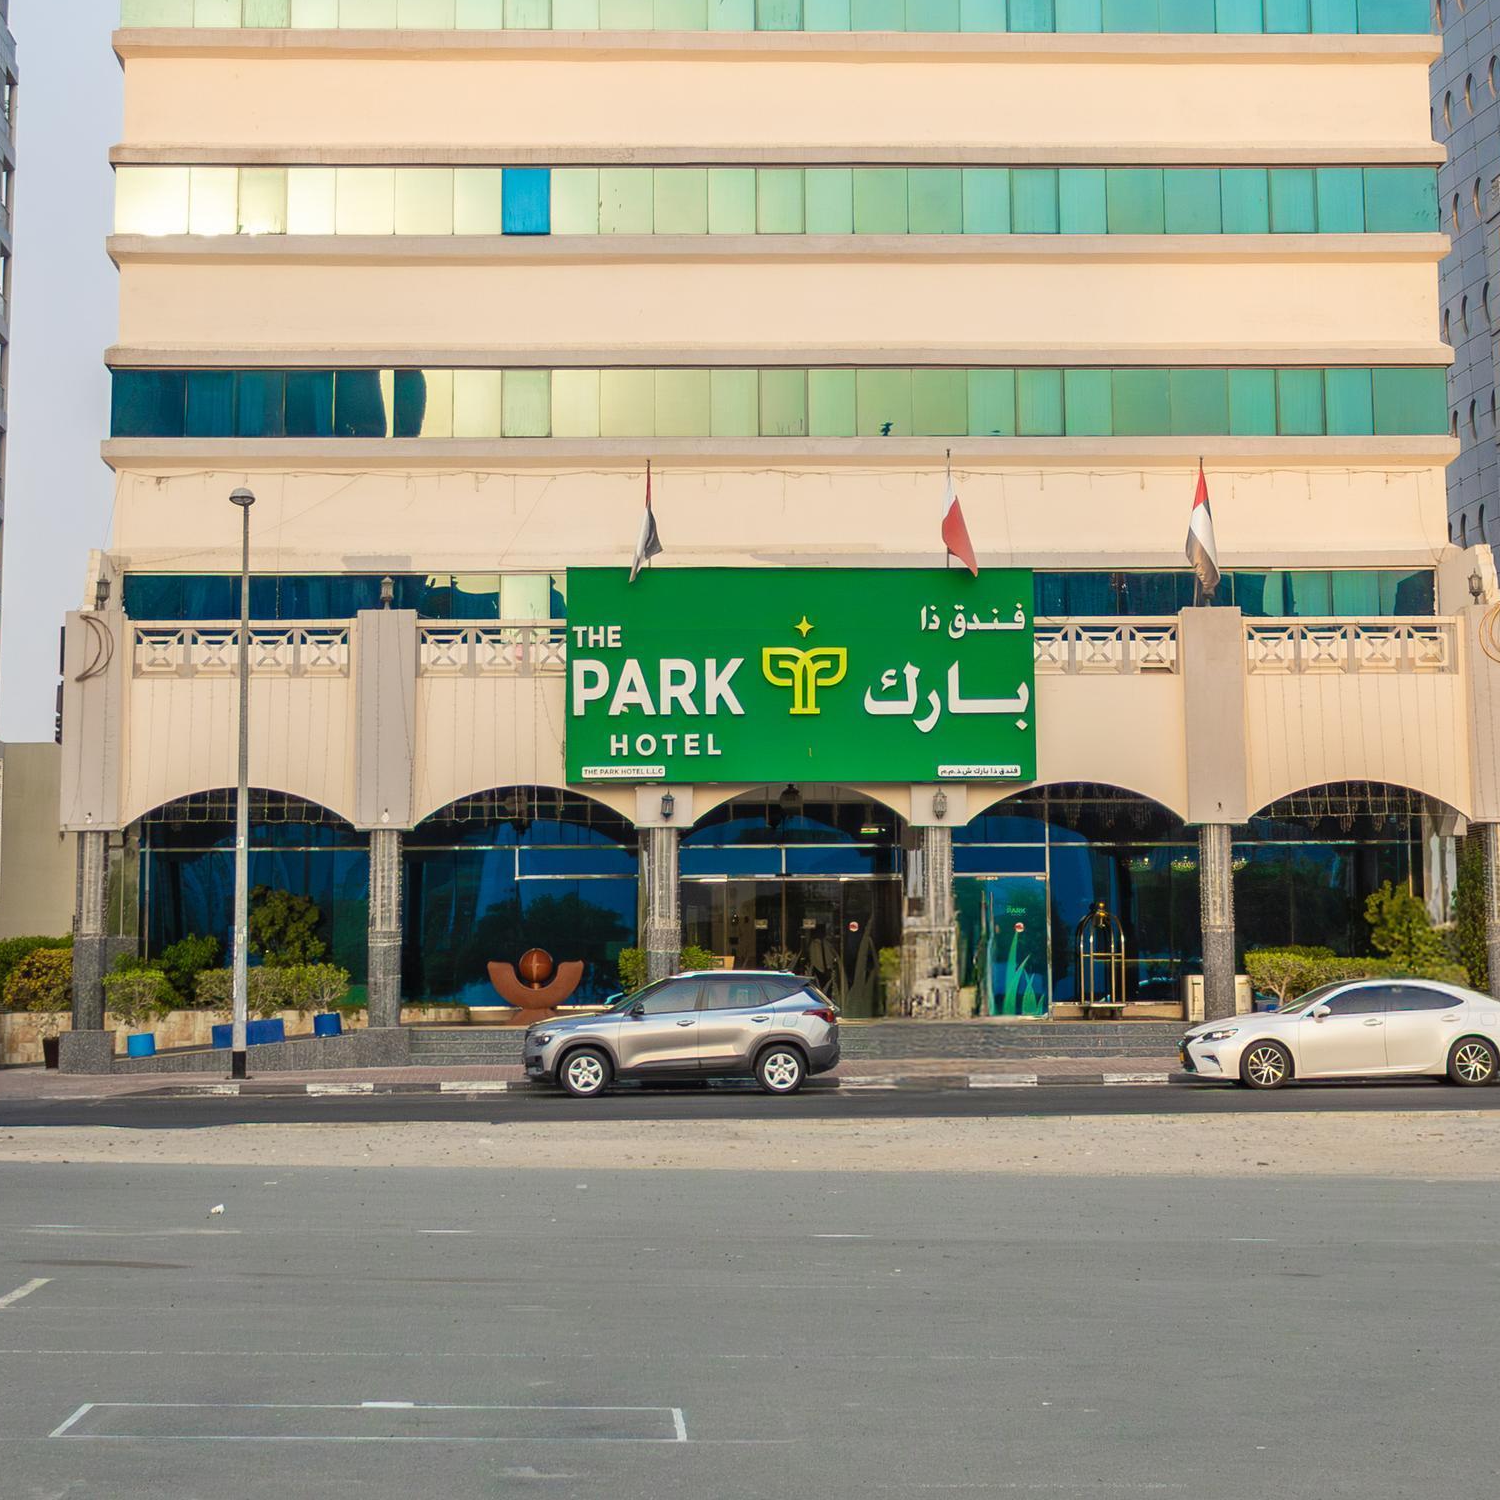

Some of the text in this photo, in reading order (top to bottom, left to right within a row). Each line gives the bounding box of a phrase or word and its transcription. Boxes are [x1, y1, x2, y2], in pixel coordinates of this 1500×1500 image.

[919, 603, 1027, 639] فندق ذا
[572, 626, 622, 648] THE
[572, 657, 745, 716] PARK
[863, 660, 1030, 733] بارك
[610, 733, 722, 756] HOTEL
[973, 767, 989, 775] بارك
[999, 766, 1018, 775] فندق
